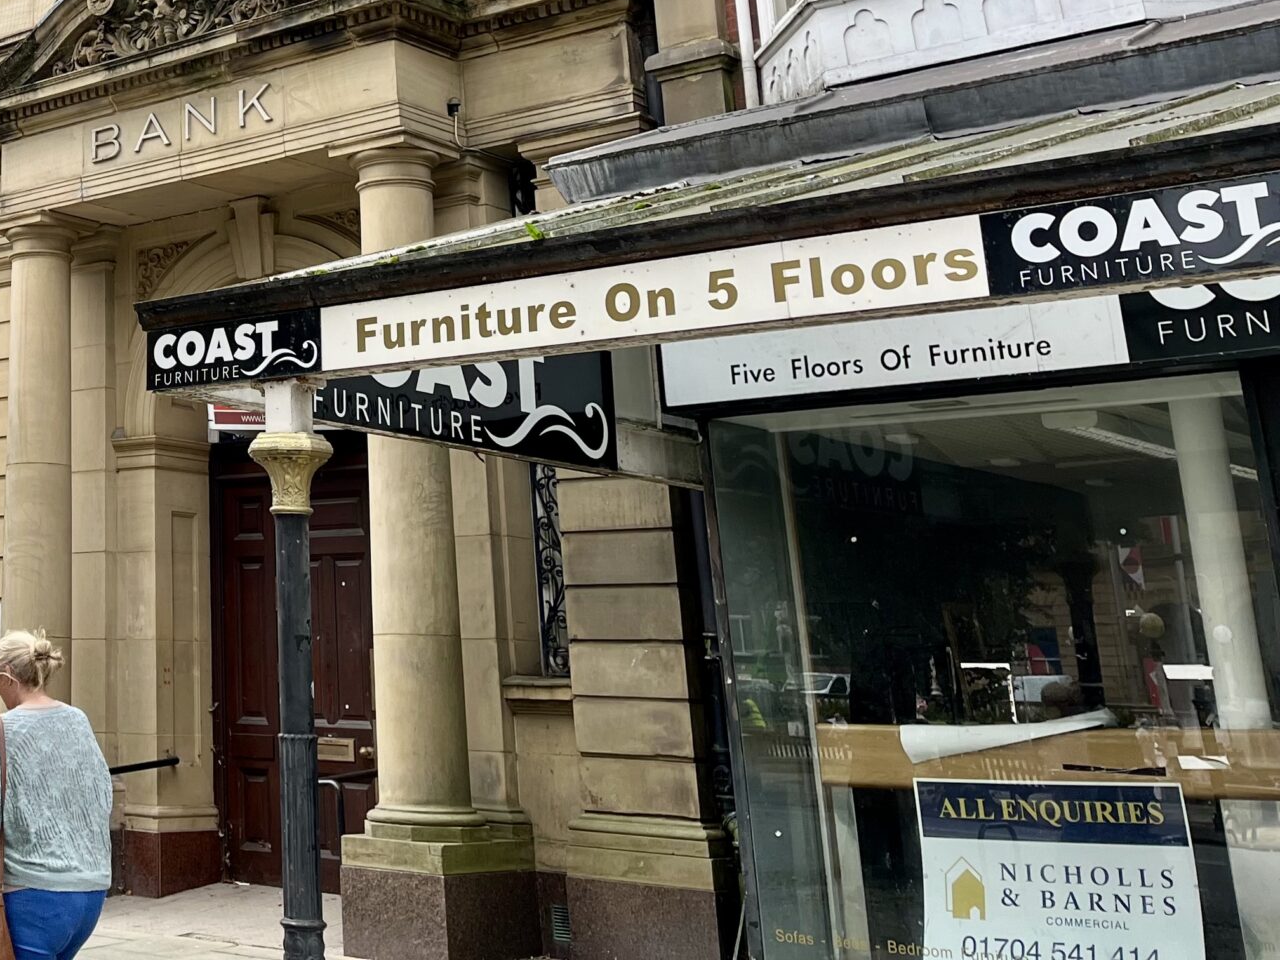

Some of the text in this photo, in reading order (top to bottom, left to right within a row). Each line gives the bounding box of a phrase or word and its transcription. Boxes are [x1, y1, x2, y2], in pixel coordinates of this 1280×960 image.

[91, 83, 273, 165] BANK
[1011, 181, 1268, 264] COAST
[1020, 250, 1196, 288] FURNITURE
[357, 244, 979, 353] Furniture On 5 Floors
[153, 320, 279, 370] COAST
[730, 336, 1052, 386] Five Floors Of Furniture
[154, 364, 240, 387] FURNITURE
[370, 356, 544, 413] AST
[313, 387, 483, 443] FURNITURE
[939, 797, 1165, 827] ALL ENQUIRIES
[999, 862, 1175, 890] NICHOLLS
[1000, 888, 1177, 916] & BARNES
[1046, 916, 1130, 931] COMMERCIAL
[775, 929, 815, 946] Sofas
[887, 940, 953, 959] Bedroom
[962, 935, 1042, 960] 01704
[1051, 941, 1096, 960] 541
